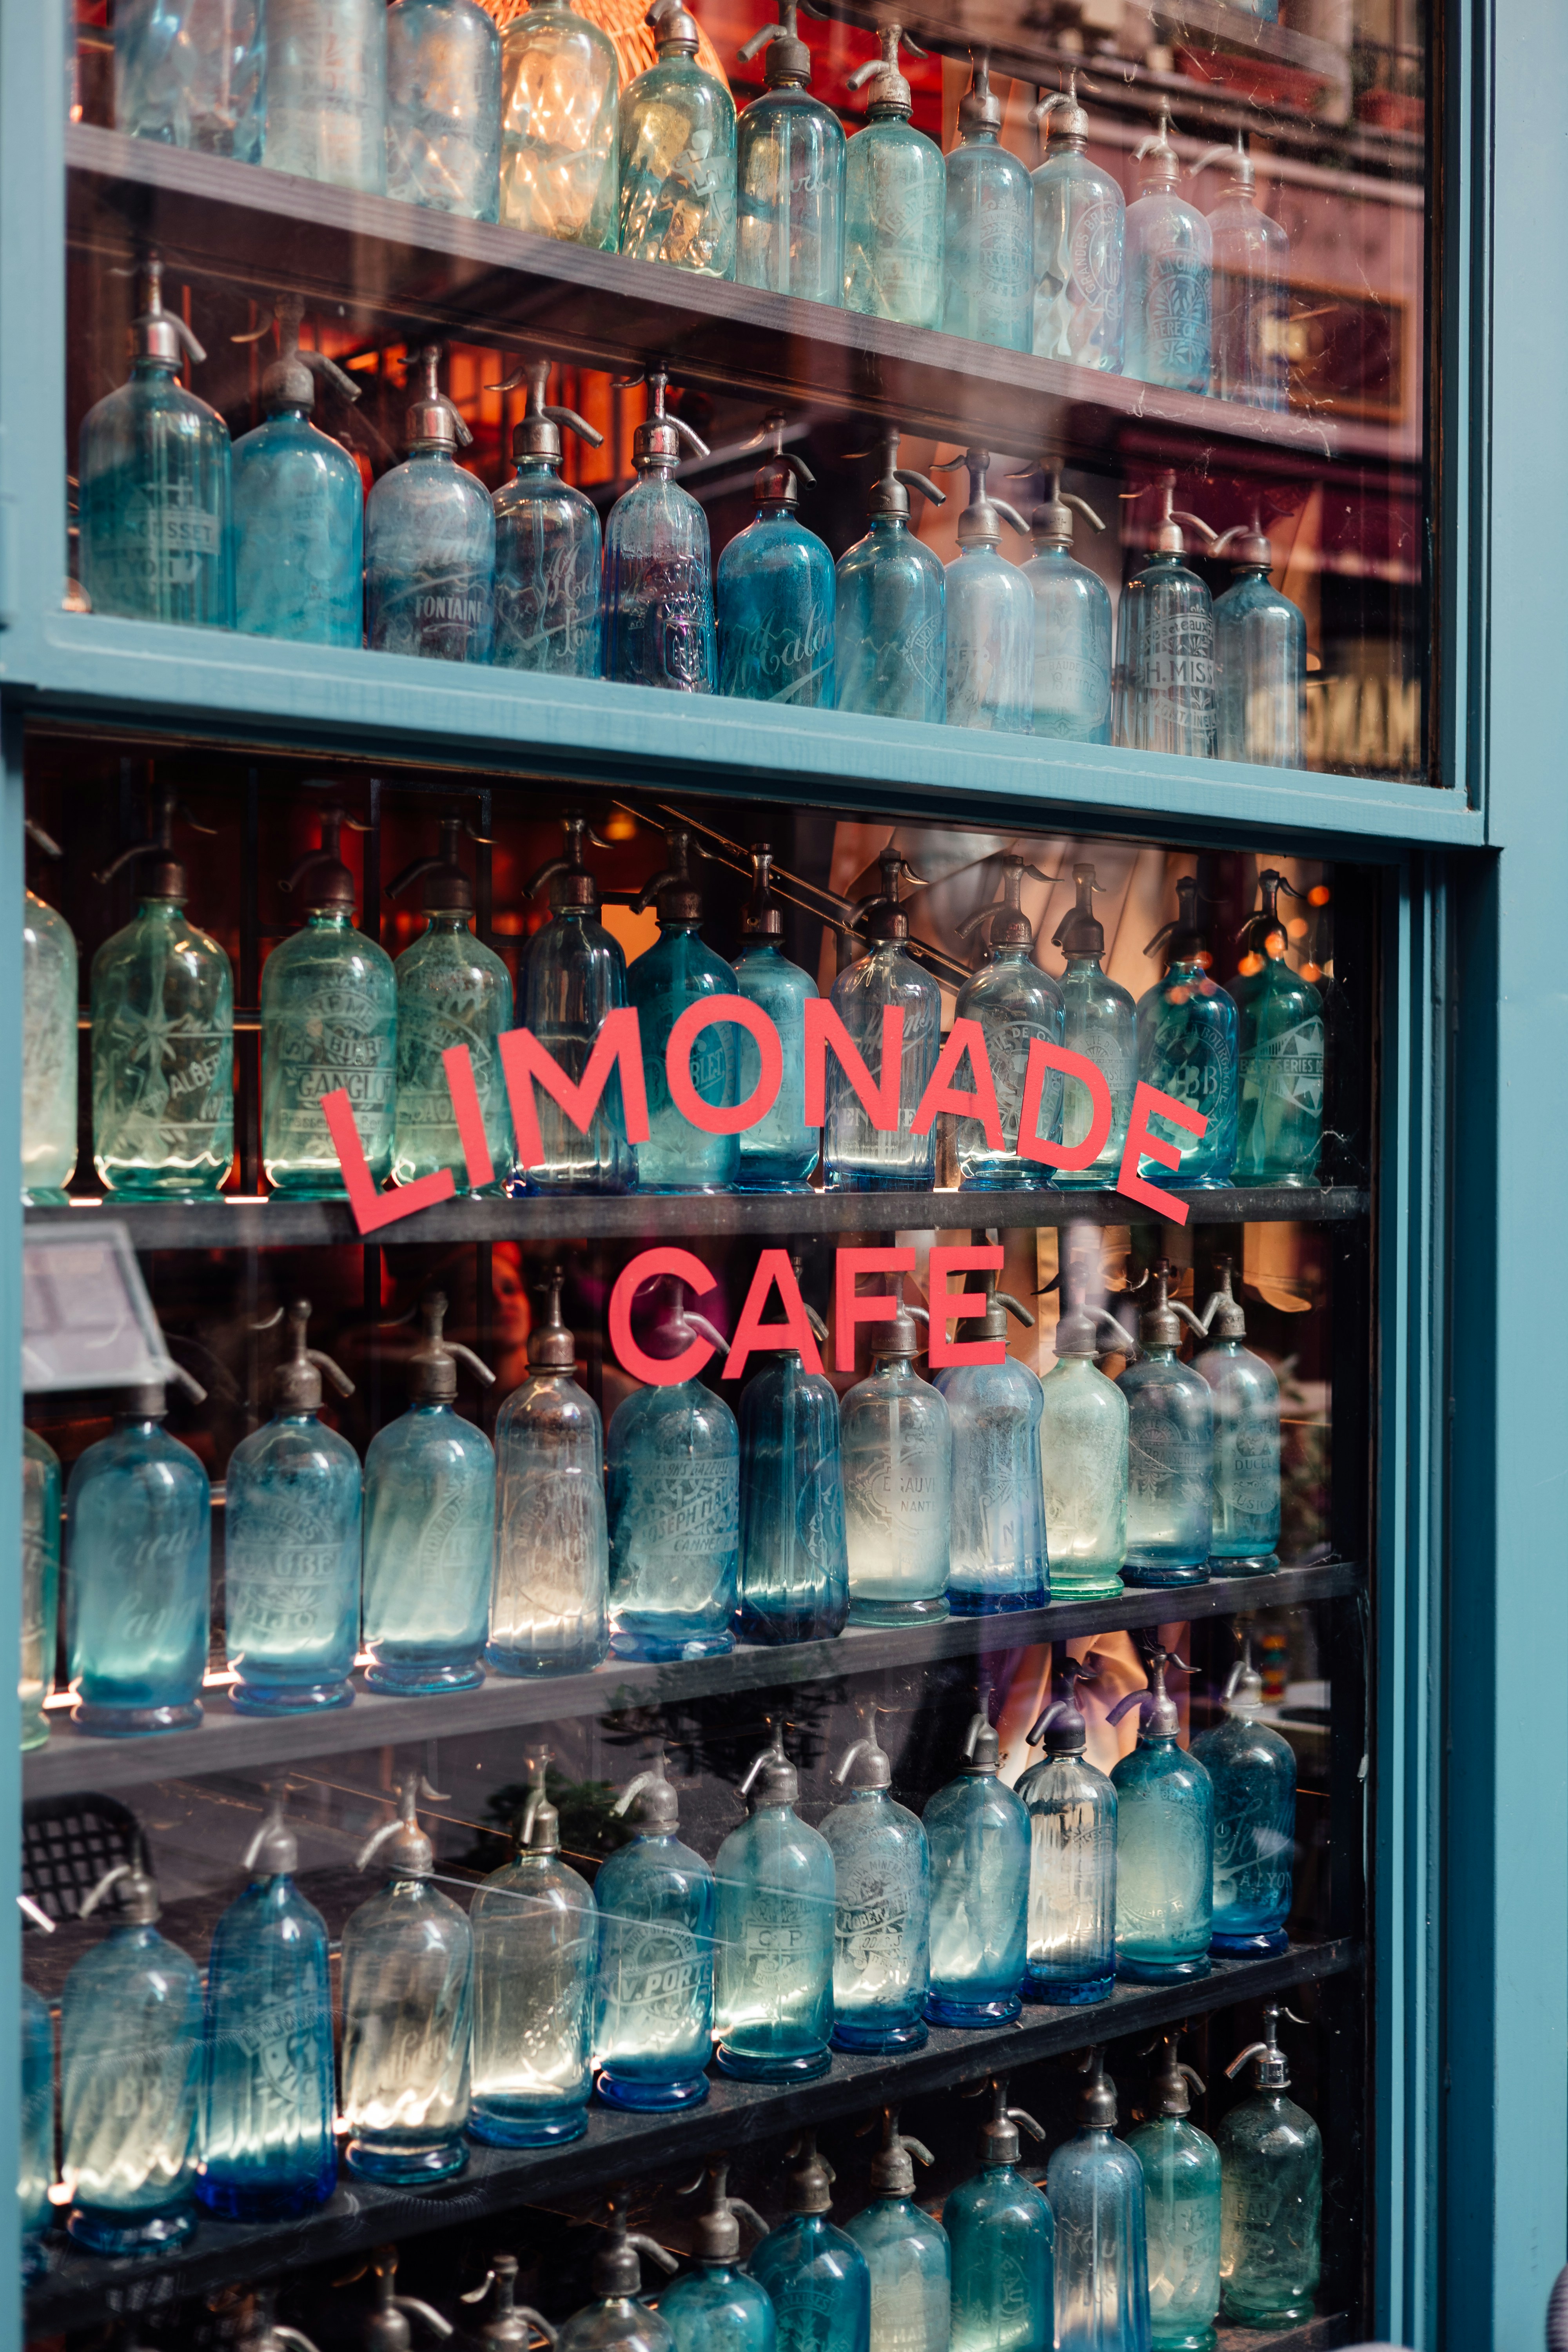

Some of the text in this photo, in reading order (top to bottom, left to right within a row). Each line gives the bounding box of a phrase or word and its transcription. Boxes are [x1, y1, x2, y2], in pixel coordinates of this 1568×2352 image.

[1075, 231, 1096, 295] GRANDES
[320, 995, 1208, 1234] LIMONADE
[1201, 1027, 1231, 1105] BOURGOGNE
[609, 1245, 1006, 1386] CAFE
